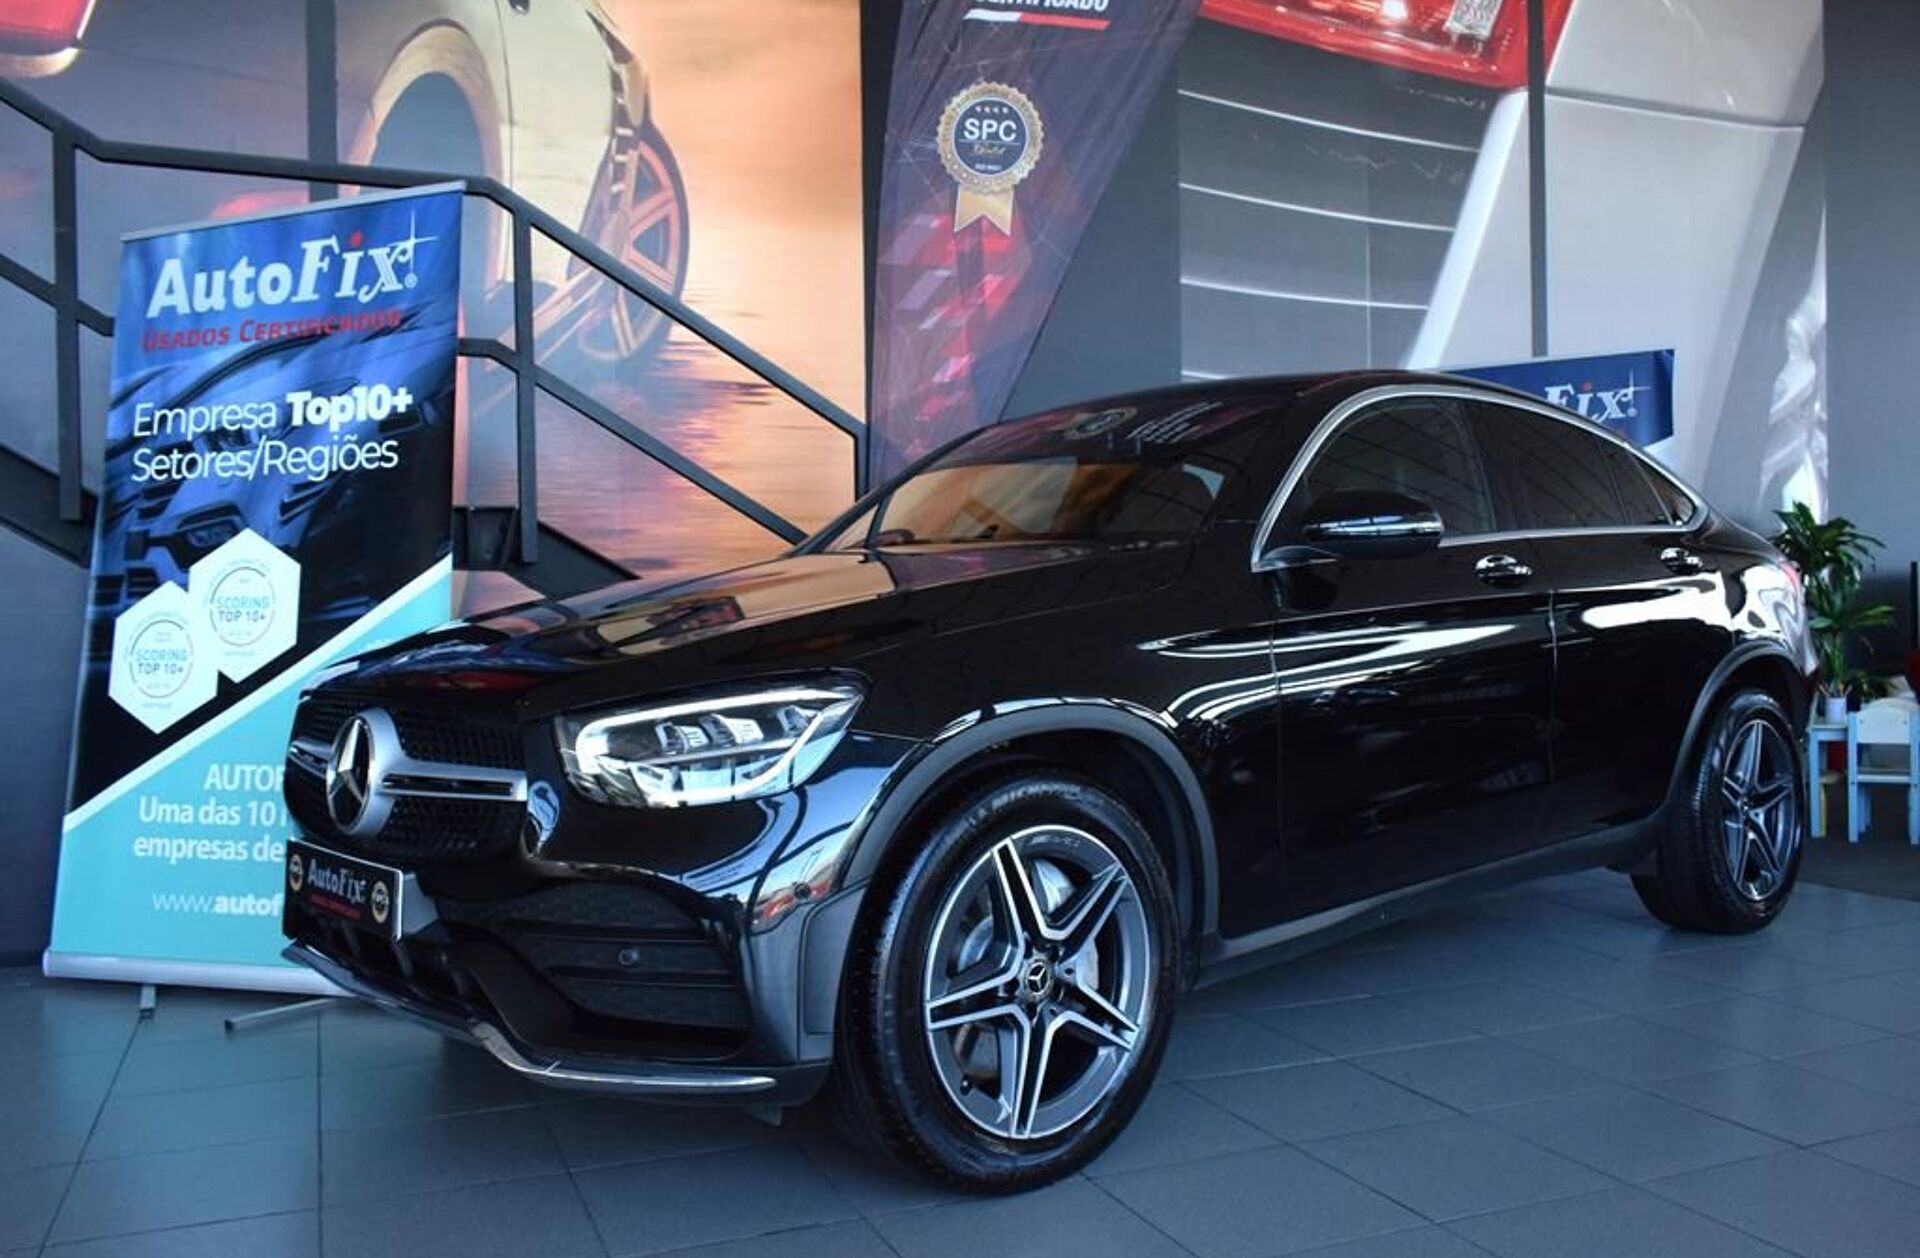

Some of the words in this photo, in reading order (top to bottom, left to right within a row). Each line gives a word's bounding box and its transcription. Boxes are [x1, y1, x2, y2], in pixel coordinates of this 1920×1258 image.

[963, 117, 1017, 142] SPC
[133, 402, 277, 441] Empresa
[286, 383, 414, 432] Top10+
[131, 433, 400, 482] Setores/Regiões
[216, 596, 271, 609] SCORING
[217, 611, 242, 623] TOP
[135, 649, 188, 662] SCORING
[138, 663, 161, 675] TOP
[139, 796, 195, 824] Uma
[198, 797, 242, 826] das
[247, 800, 277, 827] 10
[134, 836, 249, 865] empresas
[252, 834, 285, 863] de
